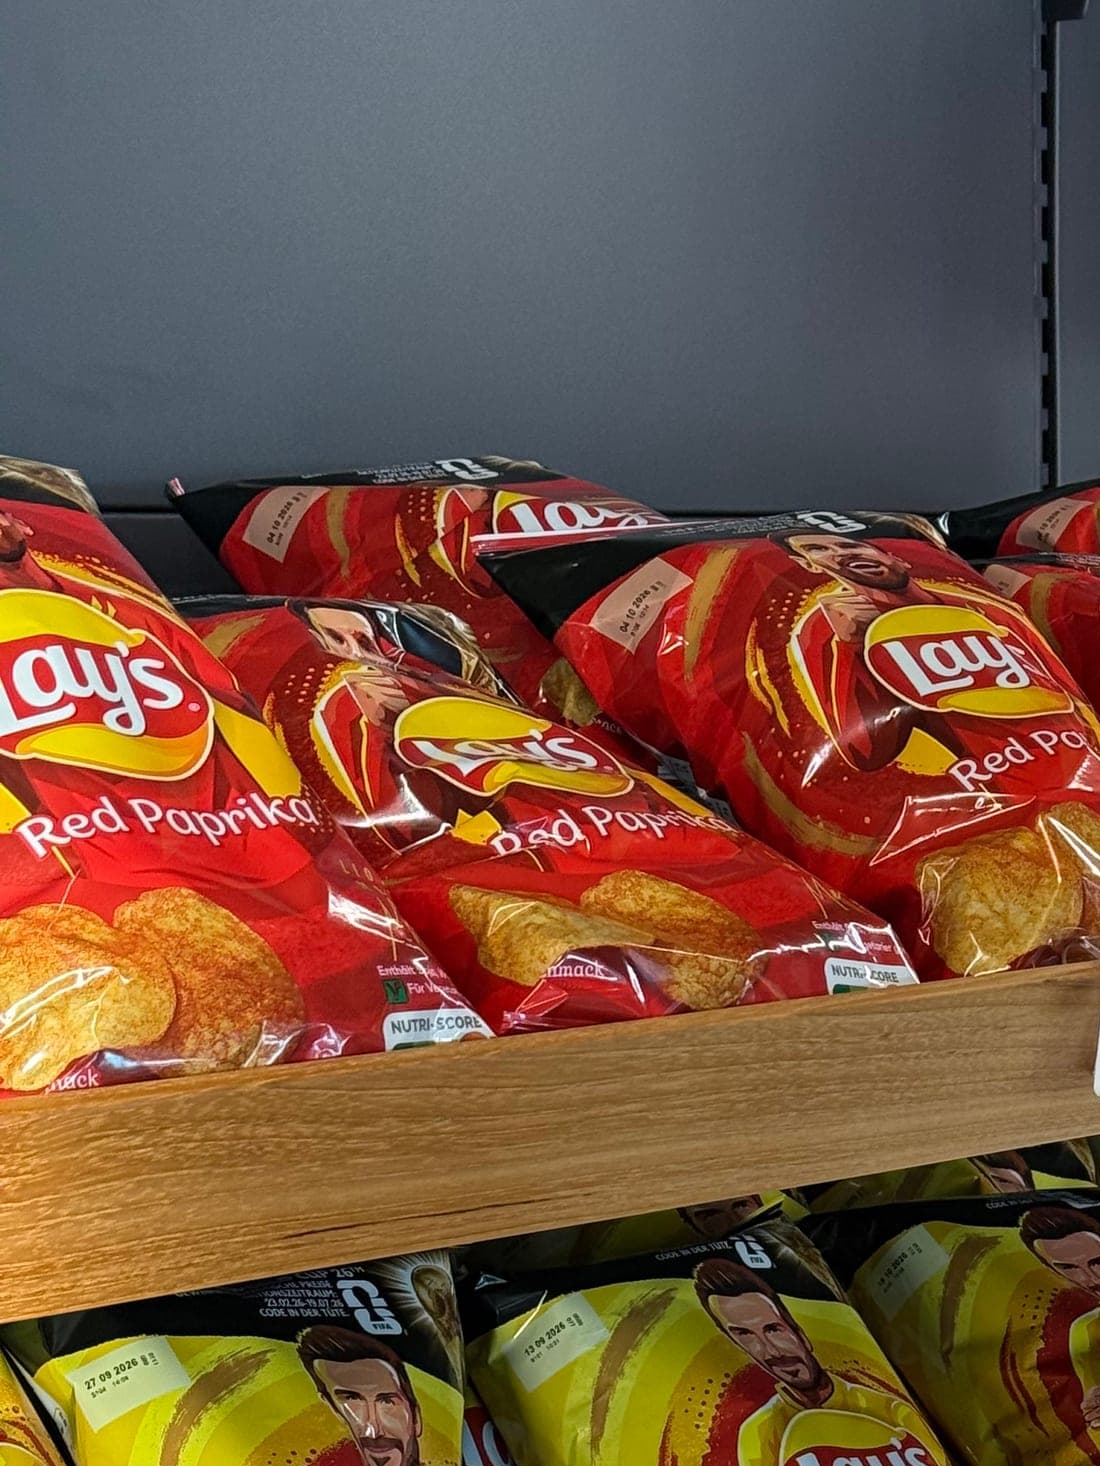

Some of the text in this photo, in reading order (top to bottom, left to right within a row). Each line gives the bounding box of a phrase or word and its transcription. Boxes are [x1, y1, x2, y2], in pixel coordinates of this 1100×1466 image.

[947, 738, 1028, 791] Red
[16, 793, 318, 859] Red Paprika
[84, 1376, 97, 1390] 27
[98, 1369, 112, 1383] 09
[113, 1357, 139, 1376] 2026
